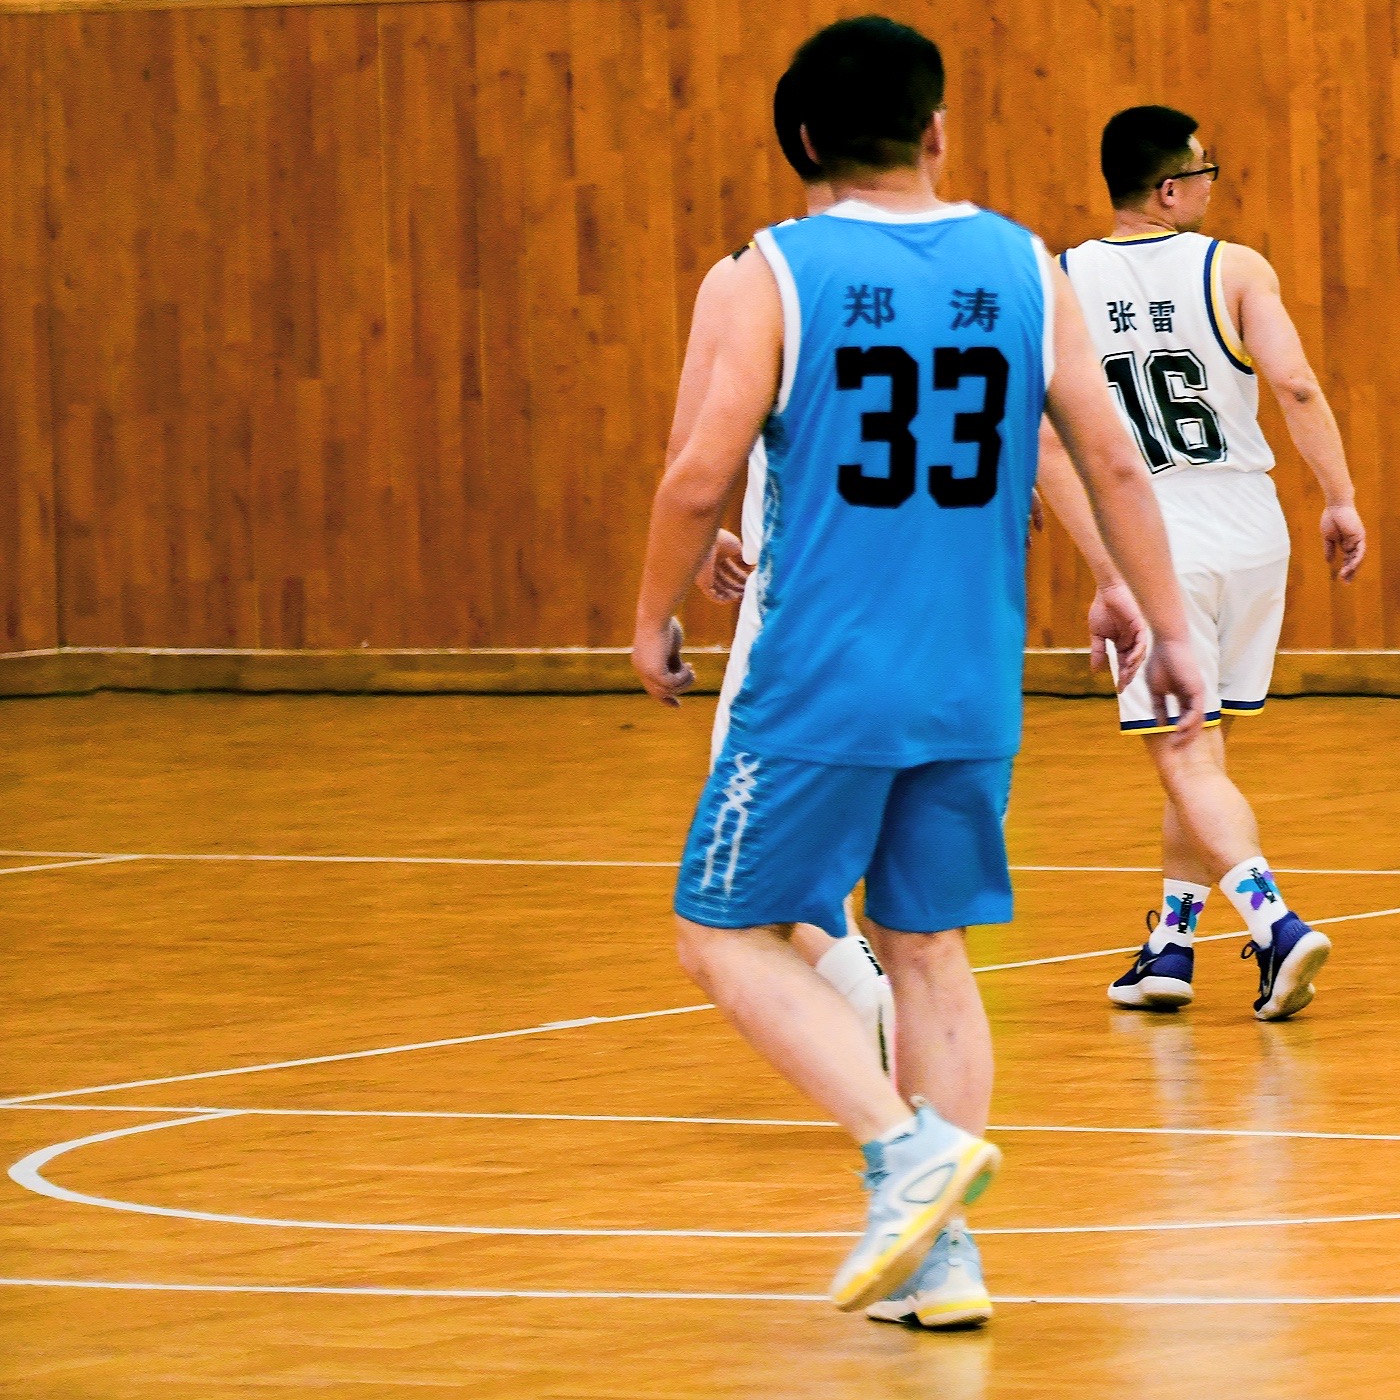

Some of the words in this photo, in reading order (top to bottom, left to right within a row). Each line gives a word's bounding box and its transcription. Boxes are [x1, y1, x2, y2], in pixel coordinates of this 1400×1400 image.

[844, 284, 1001, 333] 郑涛
[1106, 300, 1176, 334] 张雷
[835, 345, 1010, 510] 33
[1101, 349, 1228, 475] 16
